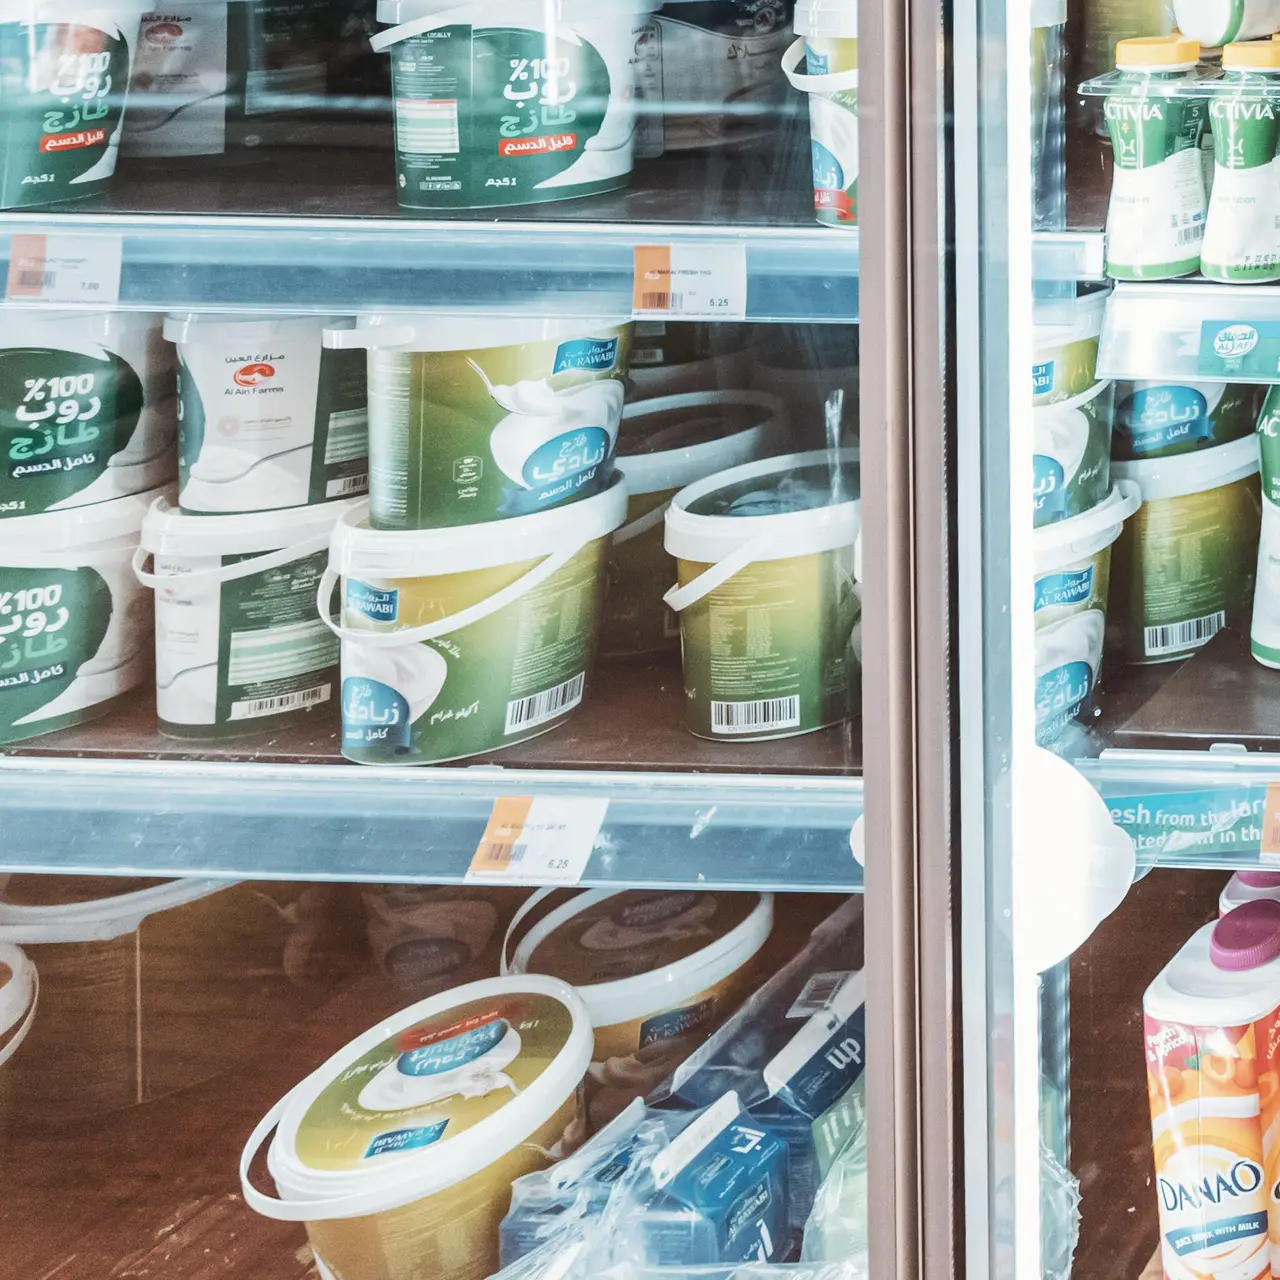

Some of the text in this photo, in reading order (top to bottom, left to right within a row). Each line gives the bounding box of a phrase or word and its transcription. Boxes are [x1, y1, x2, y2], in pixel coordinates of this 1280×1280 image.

[576, 352, 616, 365] RAWABI
[15, 396, 102, 429] روب
[9, 422, 100, 460] طازج
[12, 459, 61, 478] الدسم
[532, 444, 606, 482] زبادي
[1160, 1160, 1262, 1213] DANAO
